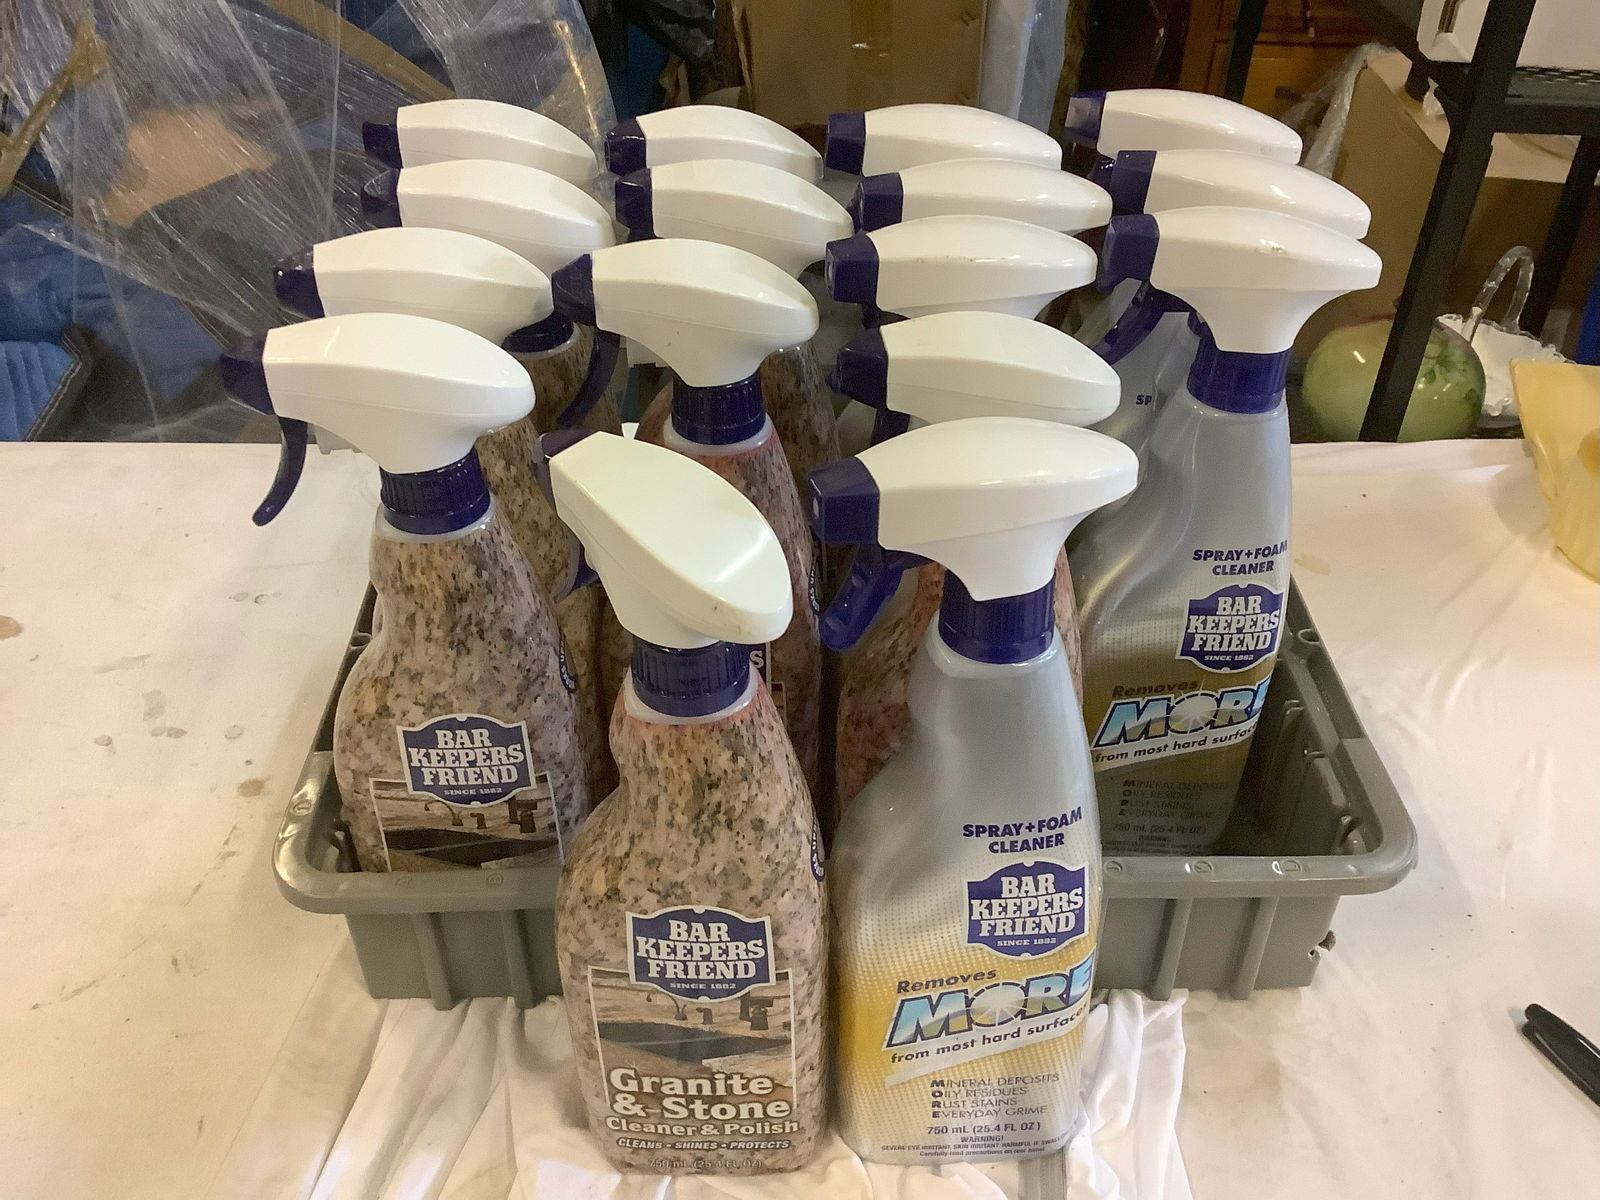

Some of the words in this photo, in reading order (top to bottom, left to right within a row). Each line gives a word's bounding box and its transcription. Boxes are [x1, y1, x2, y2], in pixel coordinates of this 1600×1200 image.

[1212, 560, 1274, 575] CLEANER
[1216, 595, 1262, 615] BAR
[1187, 608, 1280, 633] KEEPERS
[1191, 631, 1272, 651] FRIEND
[1112, 680, 1198, 697] Removes
[435, 728, 492, 748] BAR
[408, 743, 525, 767] KEEPERS
[1095, 752, 1128, 762] from
[1133, 743, 1169, 757] most
[1173, 736, 1208, 750] hard
[421, 765, 519, 786] FRIEND
[962, 806, 1083, 837] SPRAY+FOAM
[988, 832, 1065, 853] CLEANER
[1000, 873, 1056, 898] BAR
[970, 887, 1084, 920] KEEPERS
[668, 919, 730, 942] BAR
[979, 911, 1076, 937] FRIEND
[635, 936, 765, 961] KEEPERS
[647, 959, 756, 979] FRIEND
[897, 968, 997, 993] Removes
[886, 952, 1095, 1048] MORE
[891, 1049, 929, 1063] from
[936, 1040, 977, 1055] most
[982, 1025, 1021, 1046] hard
[609, 1068, 773, 1096] Granite
[930, 1079, 991, 1088] MINERAL
[997, 1073, 1060, 1087] DEPOSITS
[931, 1089, 961, 1098] OILY
[965, 1086, 1028, 1098] RESIDUES
[931, 1100, 967, 1108] RUST
[971, 1097, 1017, 1108] STAINS
[613, 1092, 646, 1117] &
[662, 1096, 791, 1120] Stone
[932, 1109, 1001, 1119] EVERYDAY
[1005, 1105, 1048, 1116] GRIME
[605, 1116, 697, 1136] Cleaner
[700, 1124, 720, 1136] &
[724, 1120, 800, 1135] Polish
[927, 1125, 948, 1135] 750
[951, 1124, 969, 1134] mL
[972, 1123, 1001, 1135] (25.4
[1004, 1123, 1017, 1132] FL
[618, 1138, 662, 1149] CLEANS
[675, 1141, 718, 1149] SHINES
[730, 1140, 790, 1149] PROTECTS
[960, 1135, 1004, 1143] WARNING!
